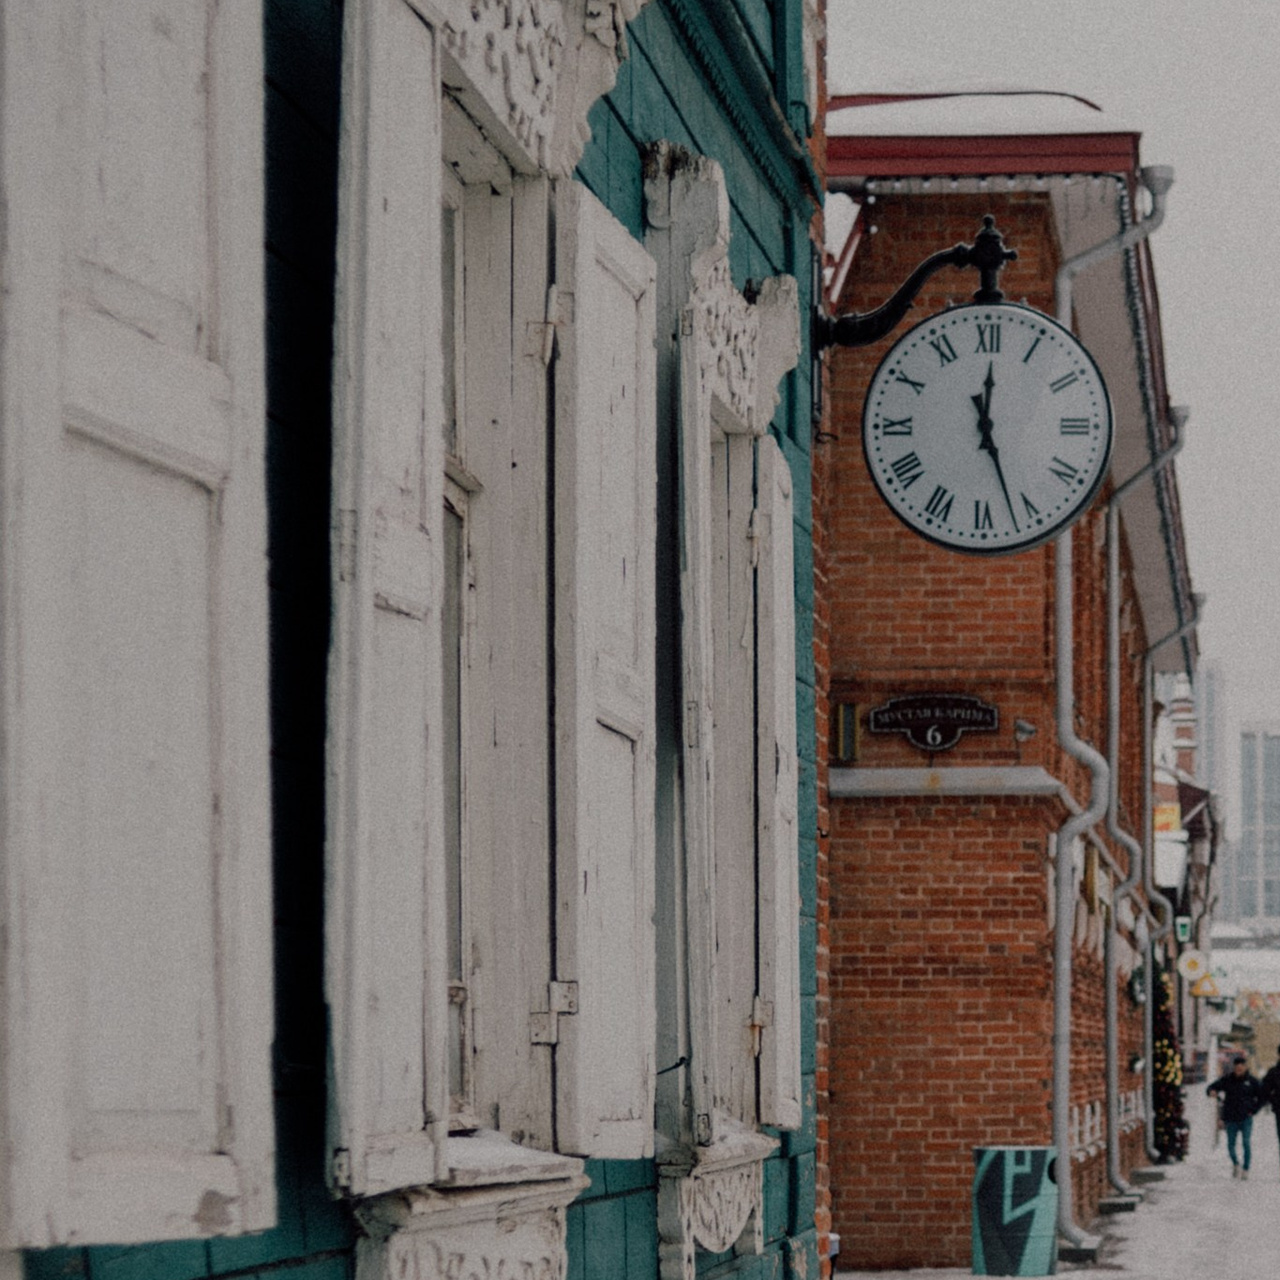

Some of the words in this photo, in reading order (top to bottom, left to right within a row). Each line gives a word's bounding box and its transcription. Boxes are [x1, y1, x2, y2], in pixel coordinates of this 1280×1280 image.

[928, 333, 958, 367] XI
[975, 323, 1001, 353] XII
[1022, 337, 1041, 363] I
[896, 370, 925, 396] X
[1049, 371, 1079, 394] II
[883, 416, 912, 436] IX
[1060, 417, 1089, 435] III
[890, 451, 925, 490] VIII
[924, 485, 955, 523] VII
[974, 500, 993, 529] VI
[1020, 492, 1040, 519] V
[926, 724, 942, 746] 6
